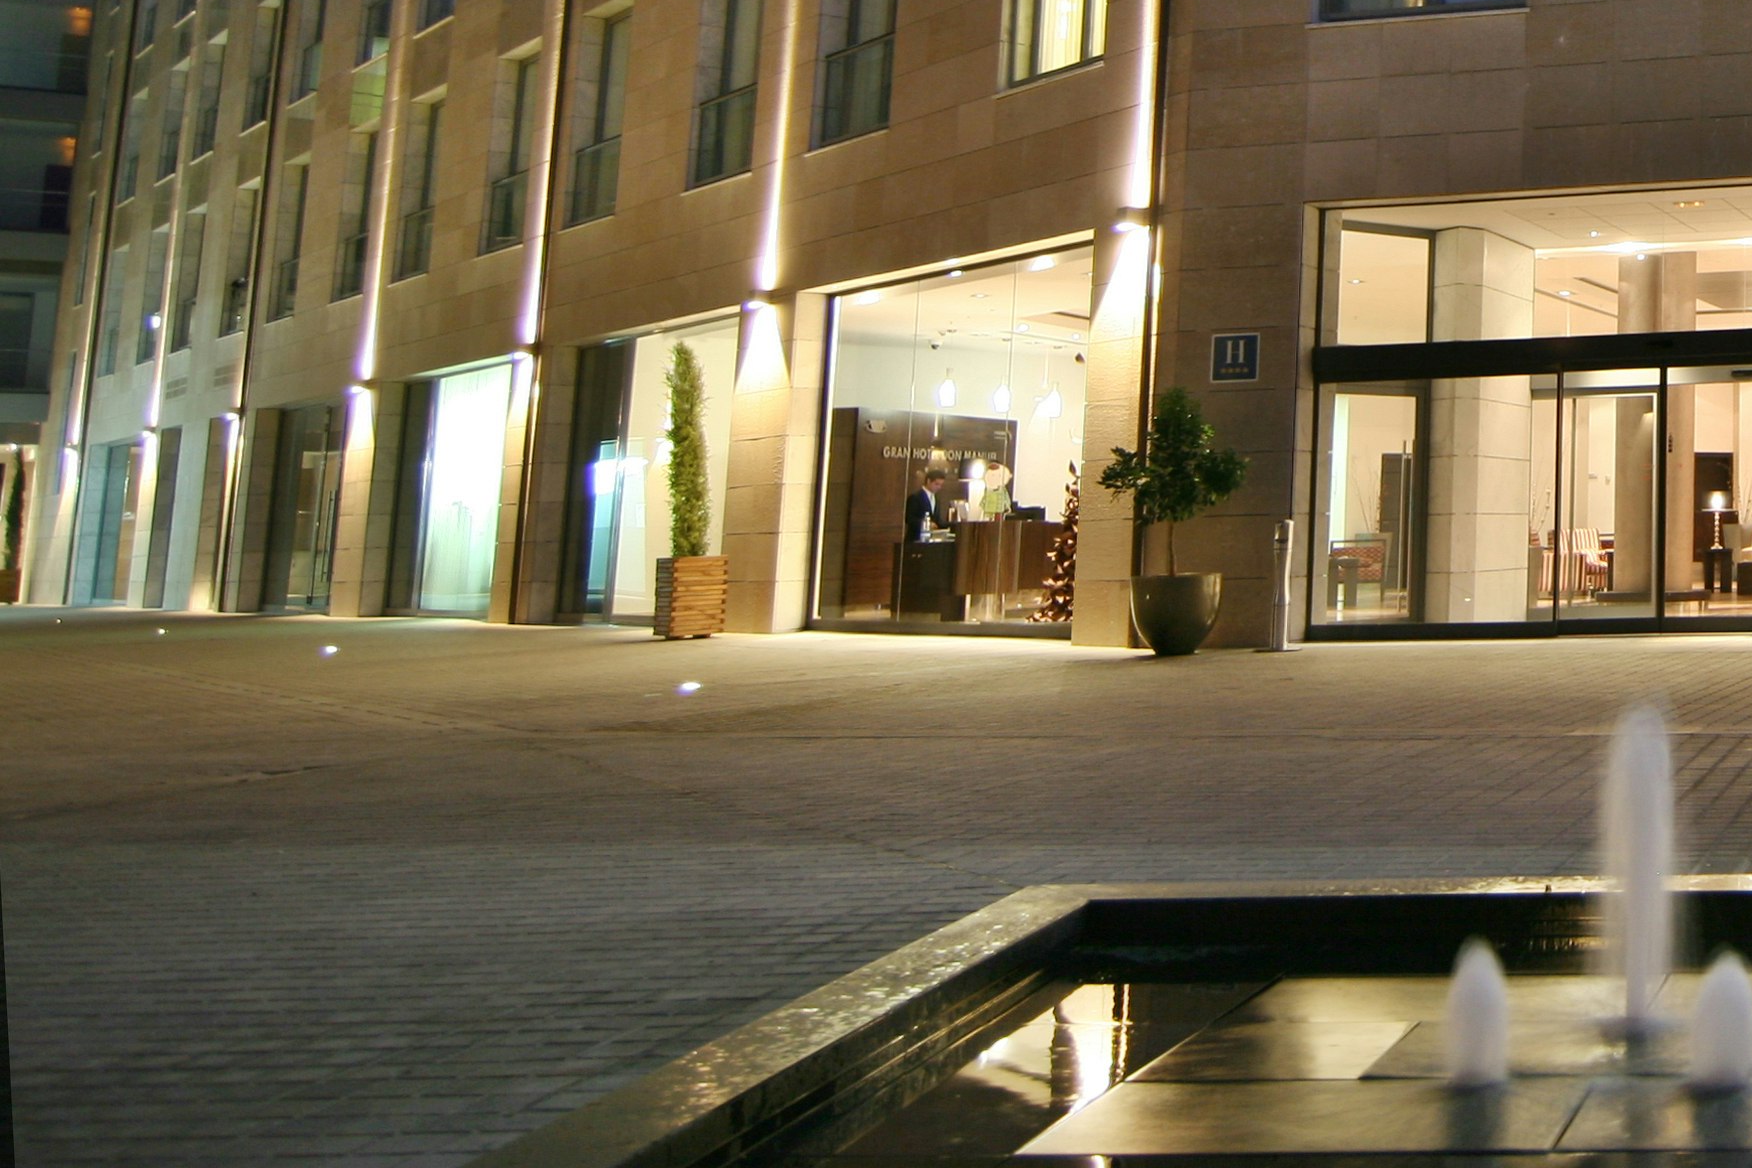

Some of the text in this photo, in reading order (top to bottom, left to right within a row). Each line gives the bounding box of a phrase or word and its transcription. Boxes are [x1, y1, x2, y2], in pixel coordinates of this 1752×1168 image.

[1226, 340, 1245, 364] H
[883, 446, 910, 458] GRAN
[913, 447, 939, 460] HOT
